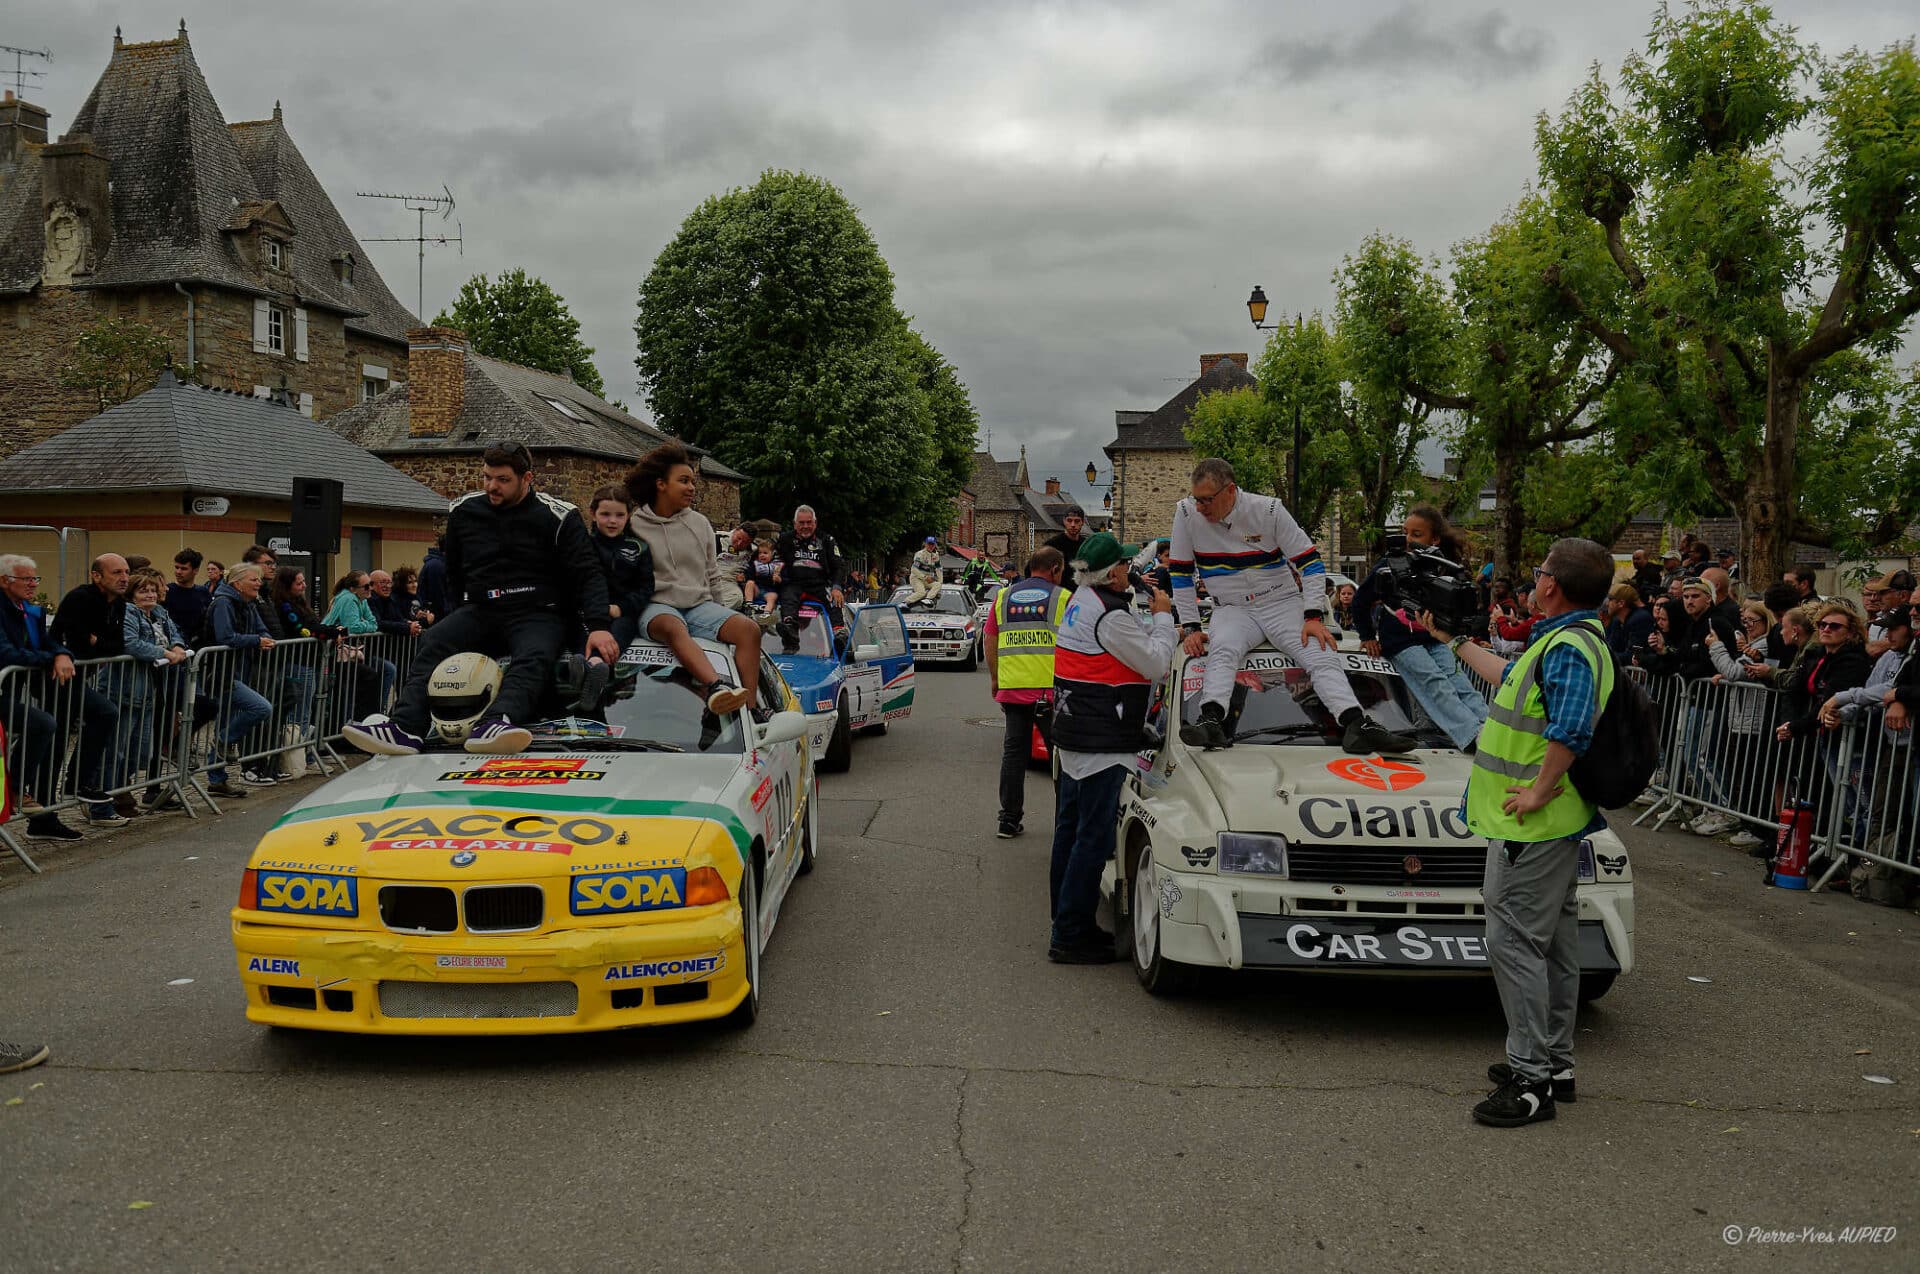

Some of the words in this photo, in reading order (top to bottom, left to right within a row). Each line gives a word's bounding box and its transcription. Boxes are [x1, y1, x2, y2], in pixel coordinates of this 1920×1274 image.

[1006, 631, 1053, 646] ORGANISATION
[1185, 679, 1203, 690] 103
[446, 770, 601, 780] FLECHARD
[1130, 799, 1158, 829] MICHELIN
[356, 814, 615, 846] YACCO
[389, 839, 553, 852] GALAXIE
[261, 875, 354, 912] SOPA
[576, 873, 682, 910] SOPA
[1286, 923, 1388, 960] CAR
[1396, 926, 1489, 961] STE
[604, 956, 718, 981] ALENÇONET
